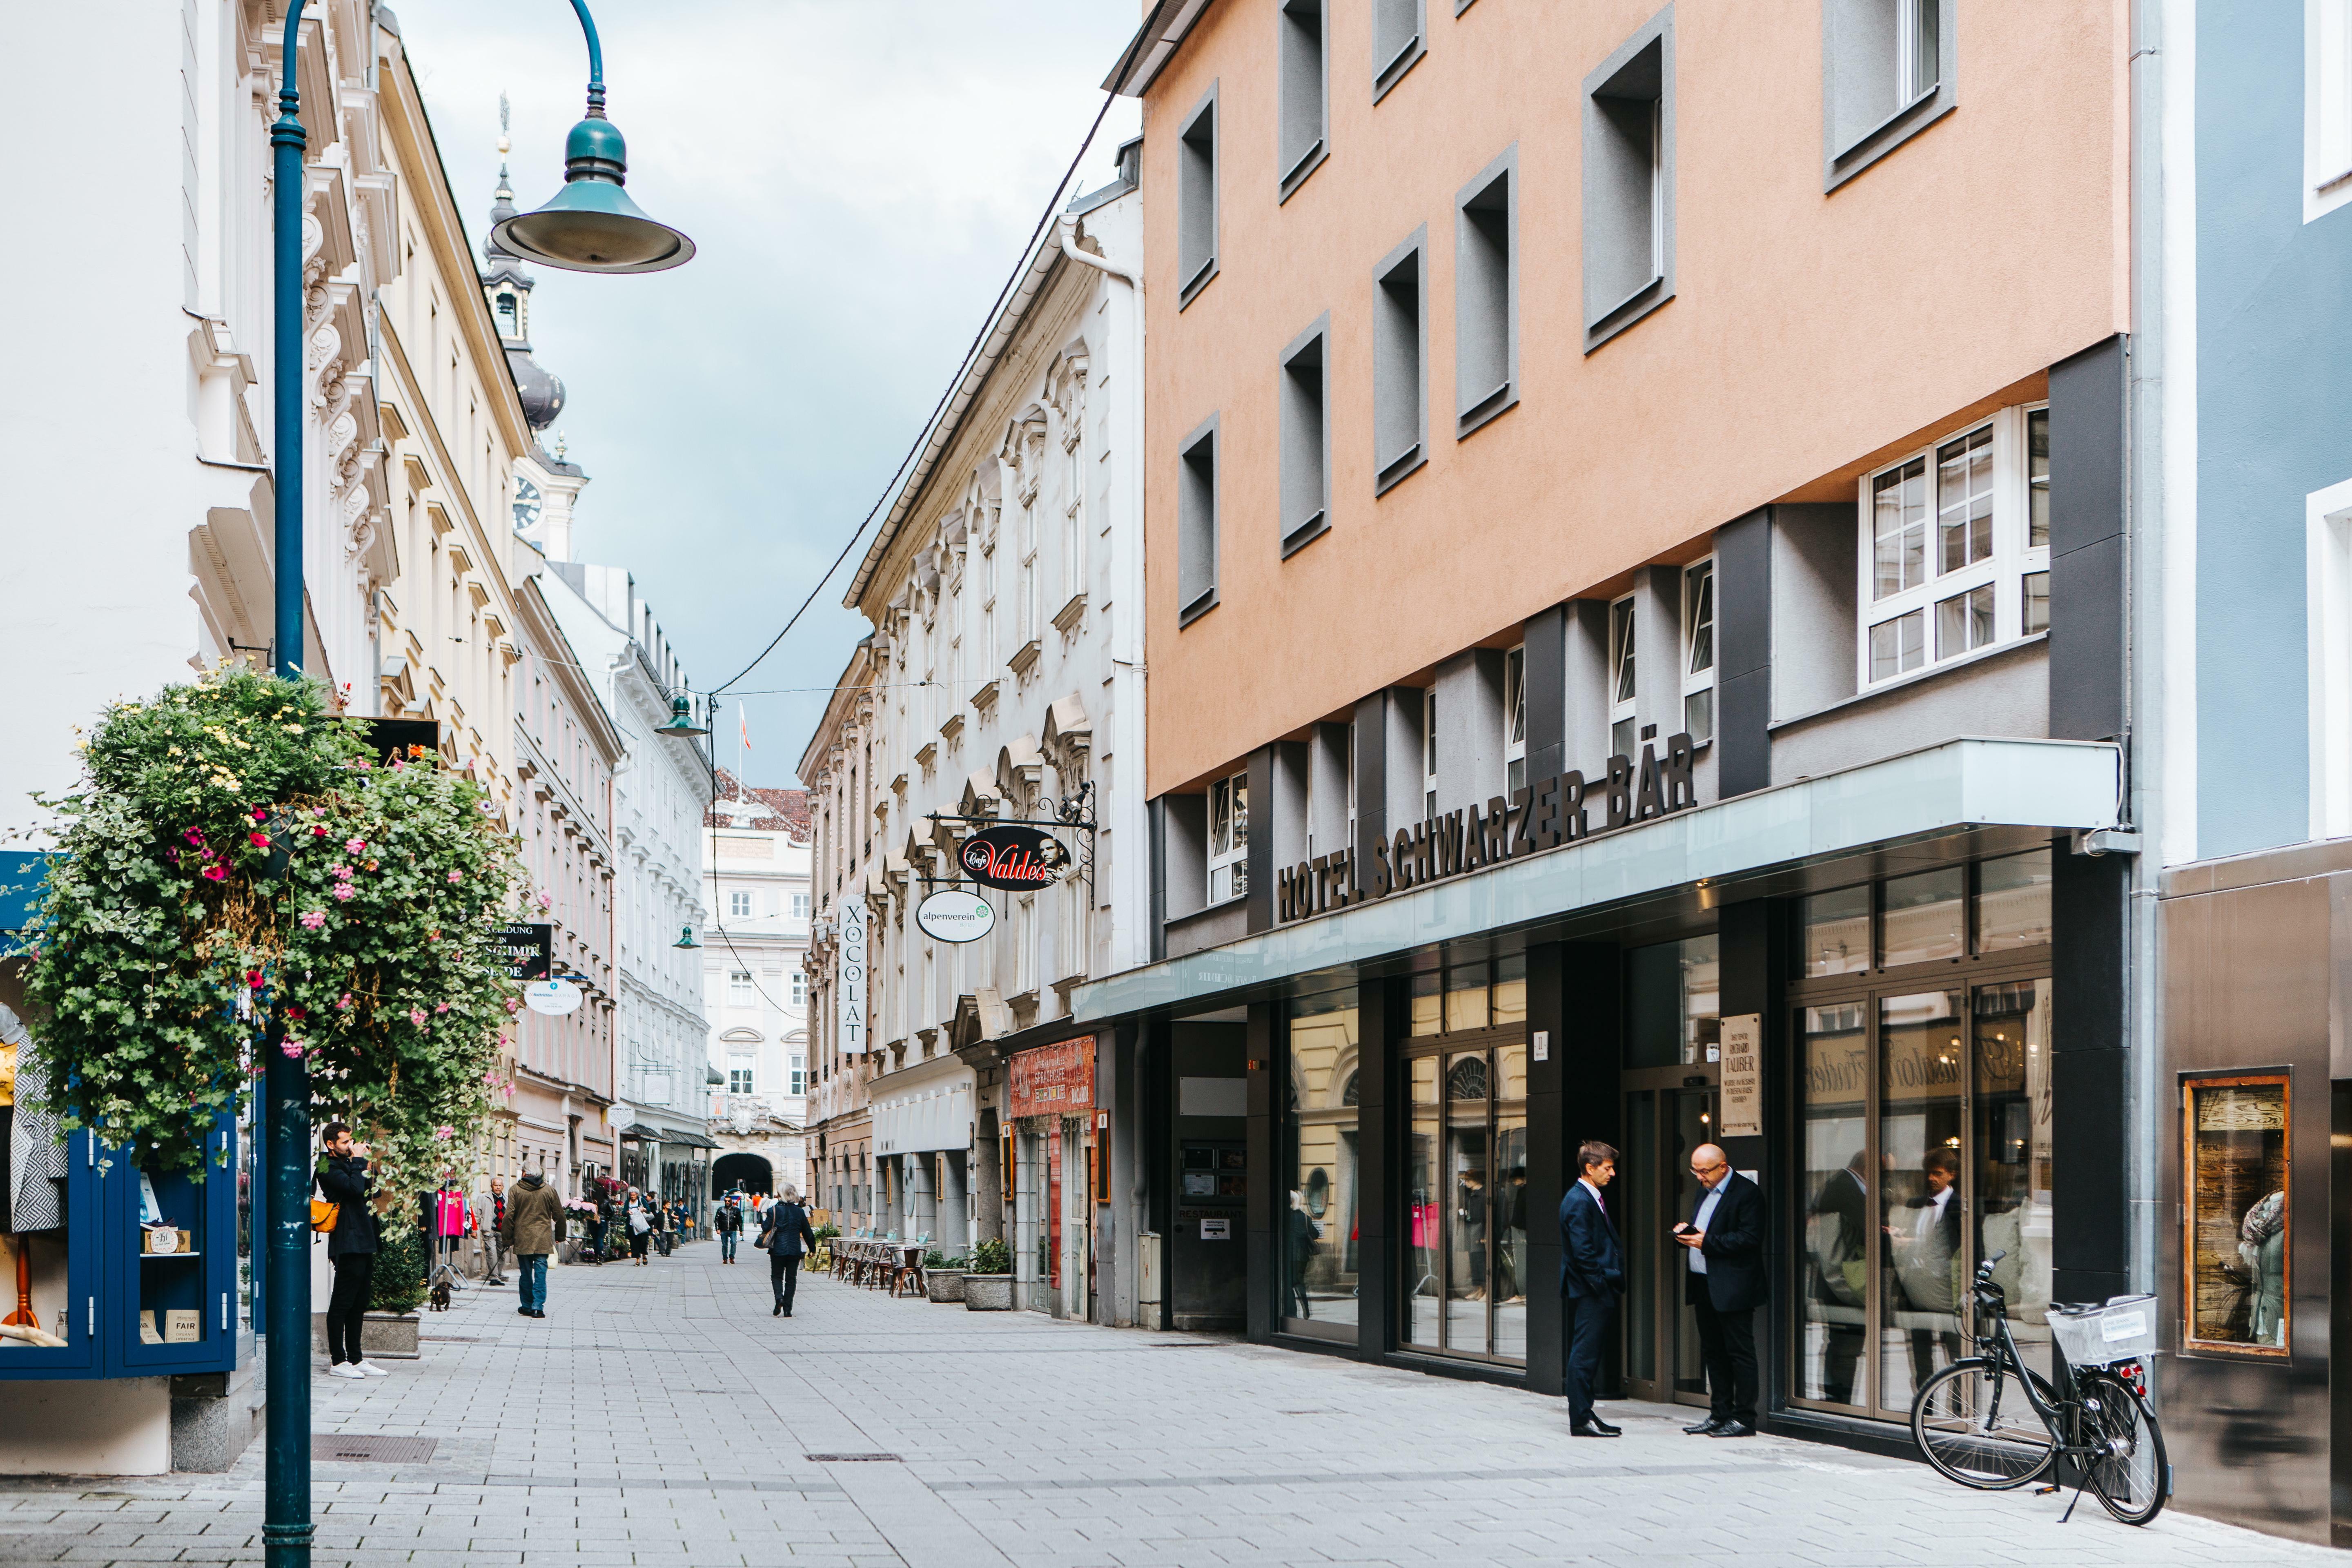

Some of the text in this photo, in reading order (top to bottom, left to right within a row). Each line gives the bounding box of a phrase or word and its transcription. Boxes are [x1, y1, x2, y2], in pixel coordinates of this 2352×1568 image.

[1279, 723, 1698, 924] HOTEL SCHWARZER BÄR
[963, 840, 1047, 881] Valdés
[923, 912, 975, 922] alpenverein
[845, 906, 862, 1041] XOCOLAT
[1538, 1037, 1542, 1050] 11
[1729, 1042, 1750, 1055] RICHARD
[1725, 1056, 1755, 1073] TAUBER
[1179, 1210, 1243, 1218] RESTAURANT
